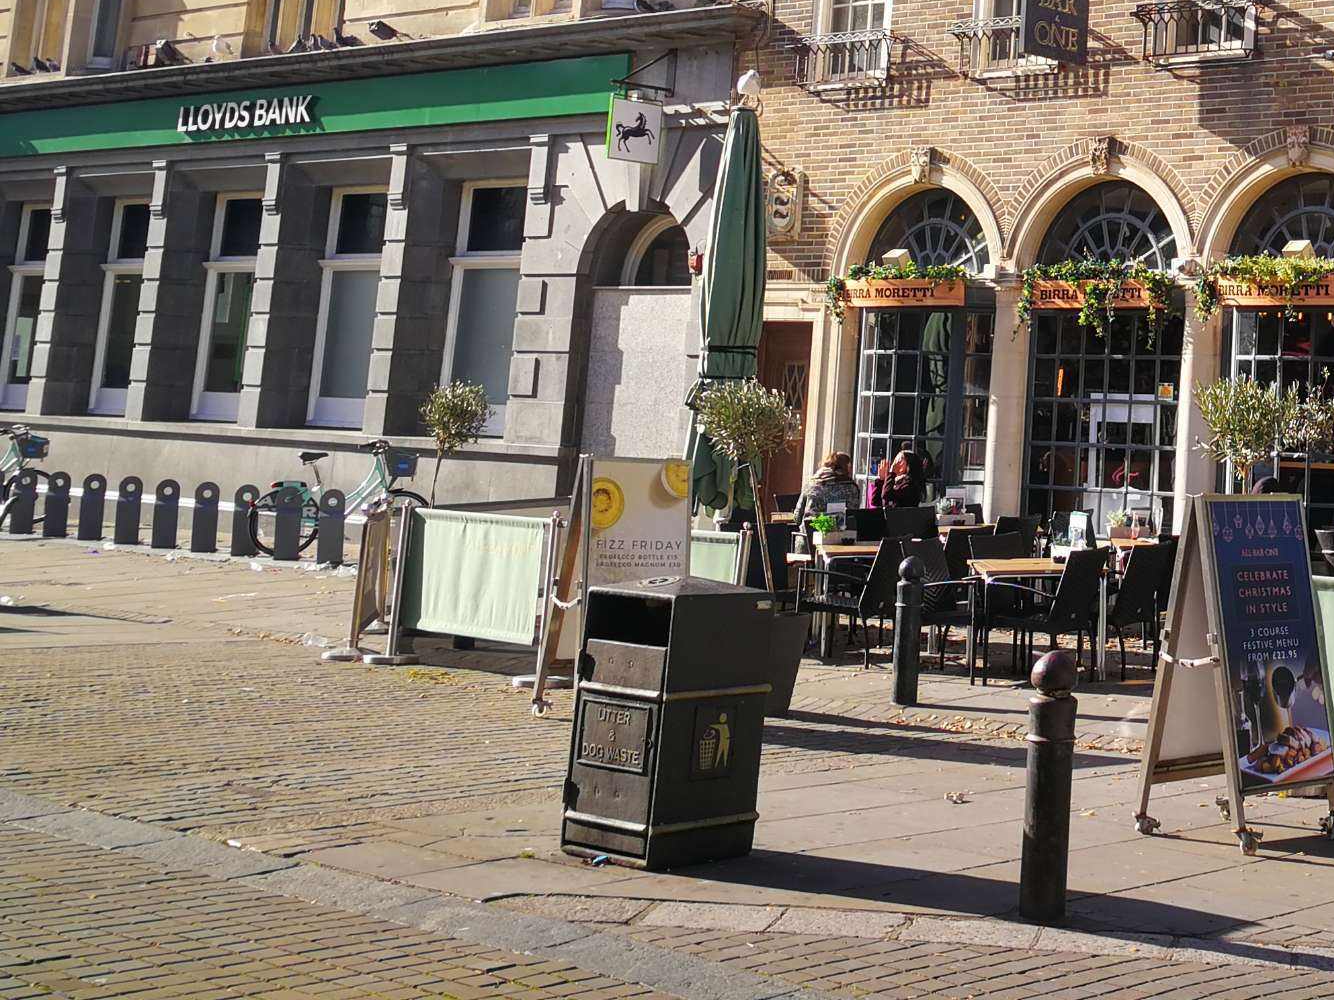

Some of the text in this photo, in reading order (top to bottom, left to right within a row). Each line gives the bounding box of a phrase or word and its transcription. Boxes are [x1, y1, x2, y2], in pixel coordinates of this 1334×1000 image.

[1034, 20, 1078, 50] ONE
[176, 95, 313, 132] LLOYDS BANK
[875, 287, 936, 299] MORETTI
[1040, 289, 1079, 301] BIRRA
[596, 539, 682, 550] FIZZ FRIDAY
[1237, 570, 1289, 581] CELEBRATE
[1239, 586, 1292, 598] CHRISTMAS
[1246, 602, 1288, 614] IN STYLE
[1257, 626, 1289, 637] COURSE
[1243, 638, 1299, 651] FESTIVE MENU
[1247, 652, 1270, 662] FROM
[599, 706, 631, 726] LITTER
[582, 742, 640, 765] DOG WASTE
